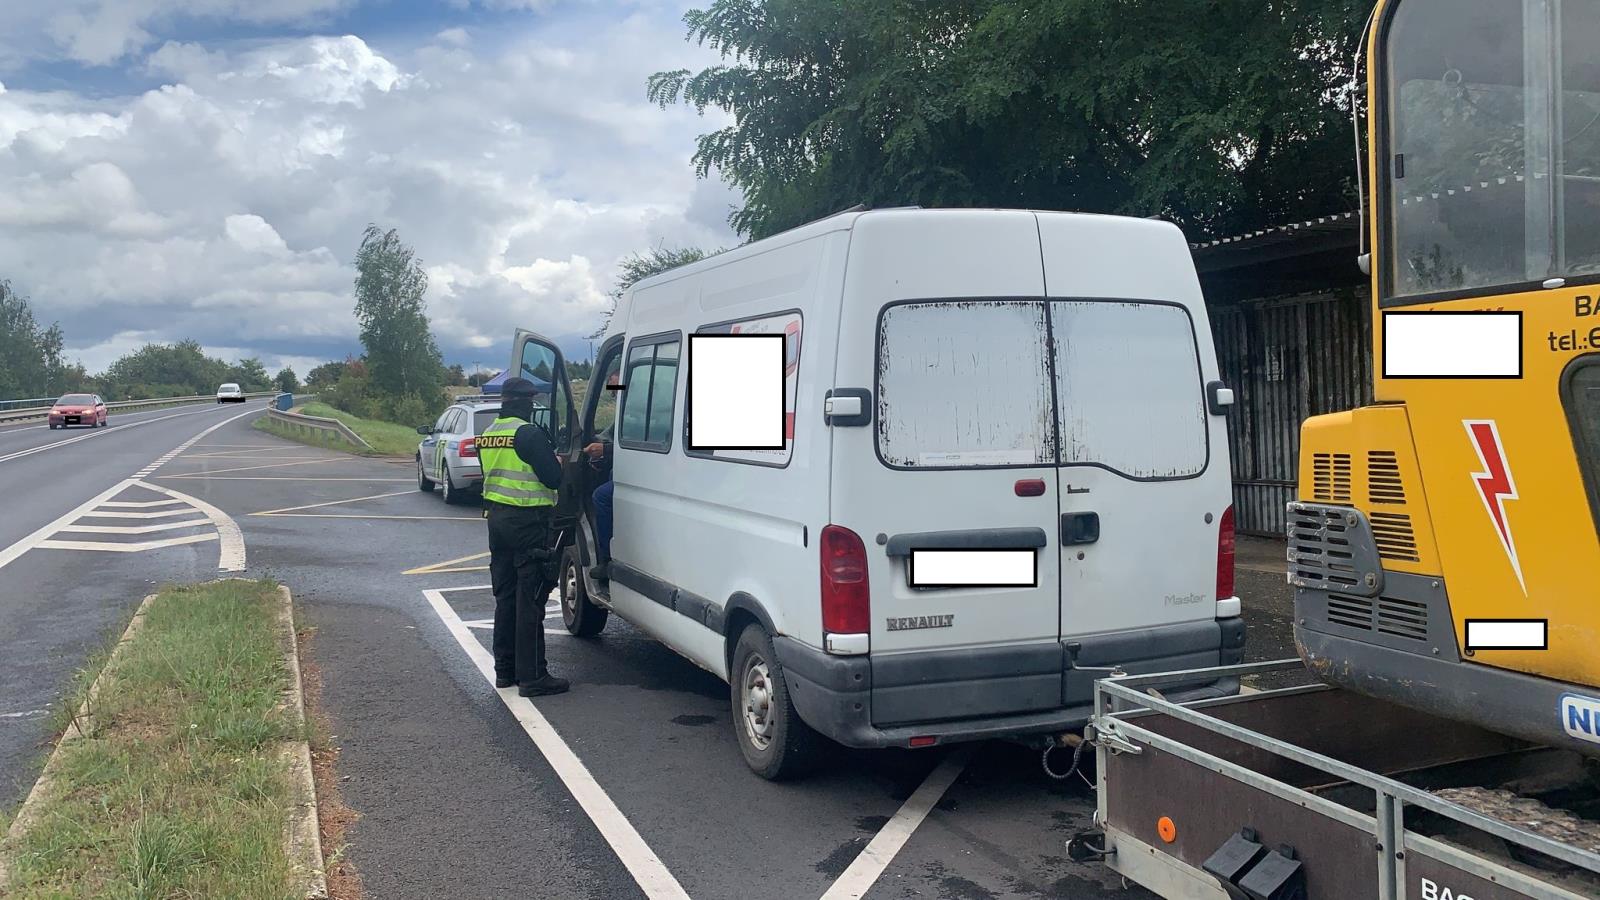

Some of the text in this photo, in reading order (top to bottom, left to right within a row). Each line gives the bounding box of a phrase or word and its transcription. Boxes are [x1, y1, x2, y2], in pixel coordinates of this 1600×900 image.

[475, 436, 515, 448] POLICIE
[1163, 592, 1207, 607] Master
[886, 614, 954, 632] RENAULT
